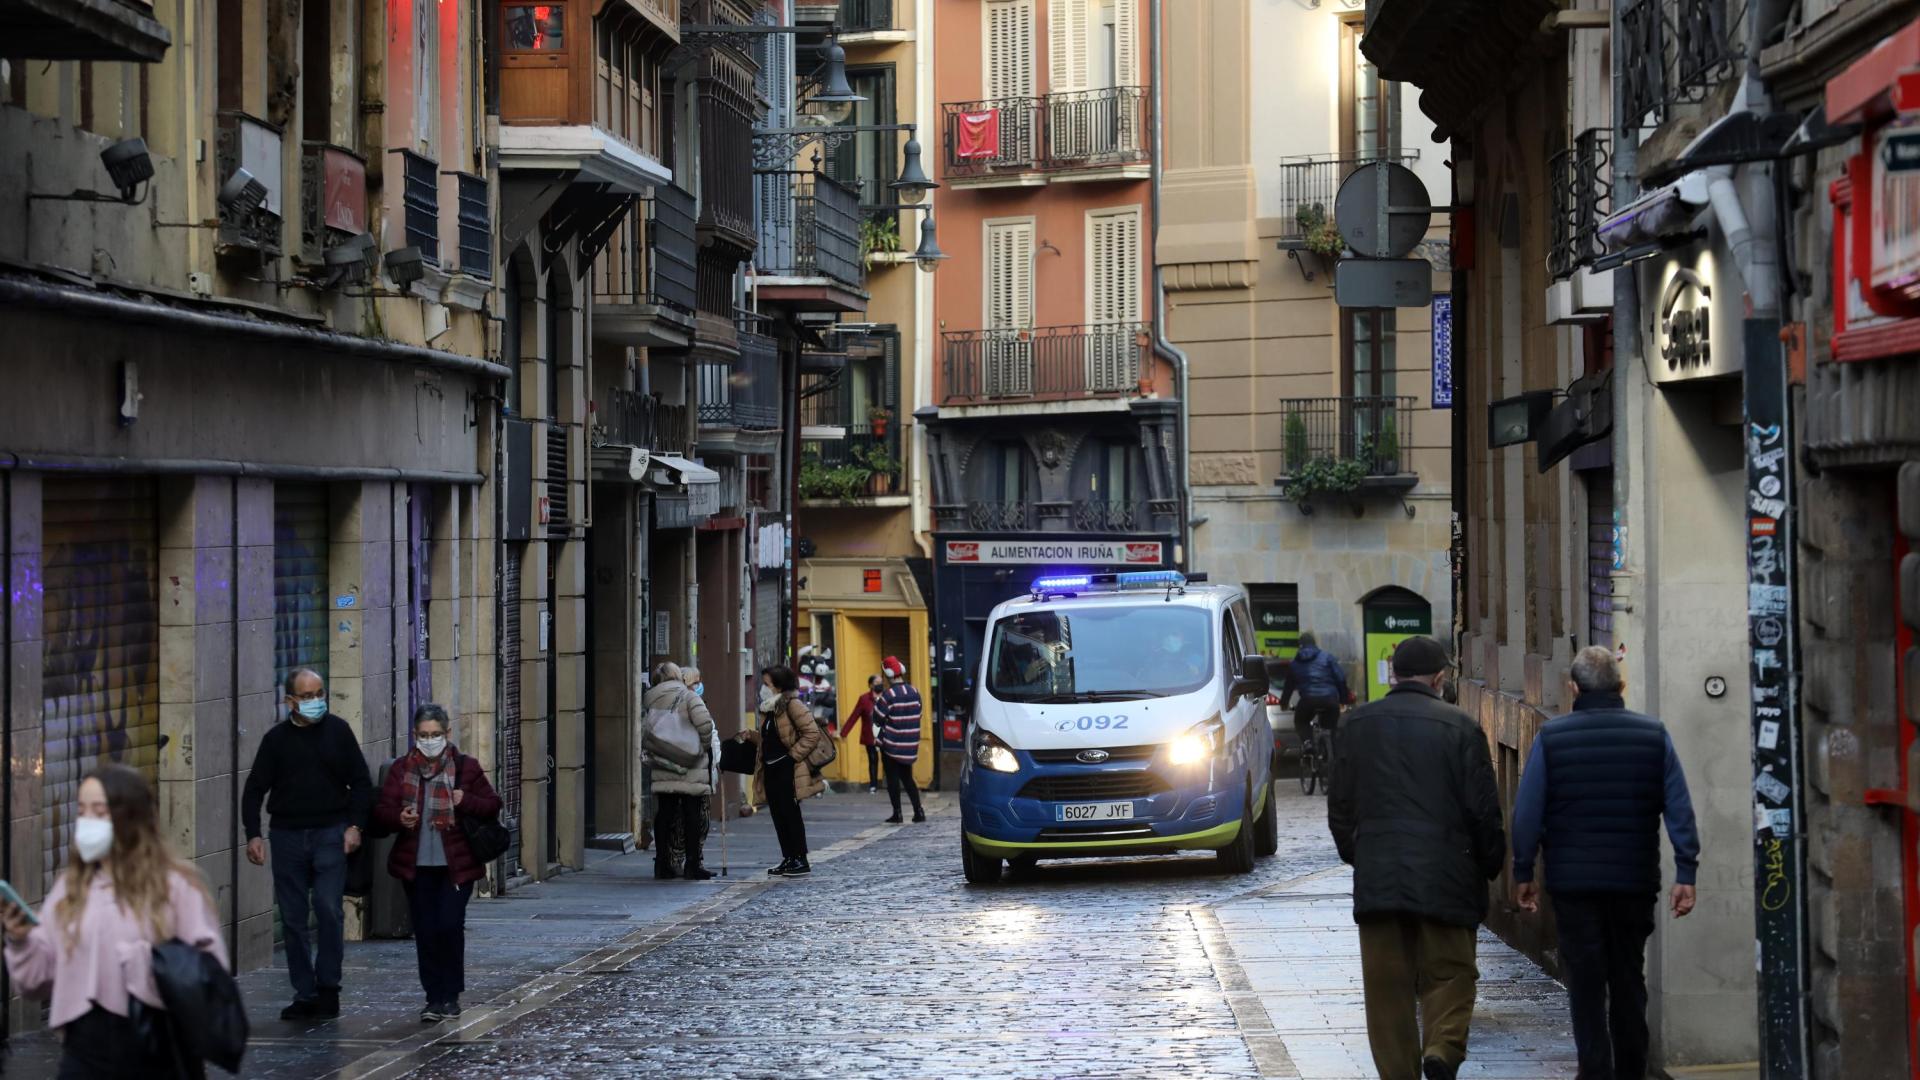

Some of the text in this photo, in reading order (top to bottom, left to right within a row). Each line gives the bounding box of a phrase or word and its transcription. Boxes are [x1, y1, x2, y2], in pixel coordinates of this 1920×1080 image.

[991, 544, 1113, 559] ALIMENTACION IRUÑA
[1076, 715, 1129, 731] 092
[1065, 804, 1130, 819] 6027 JYF
